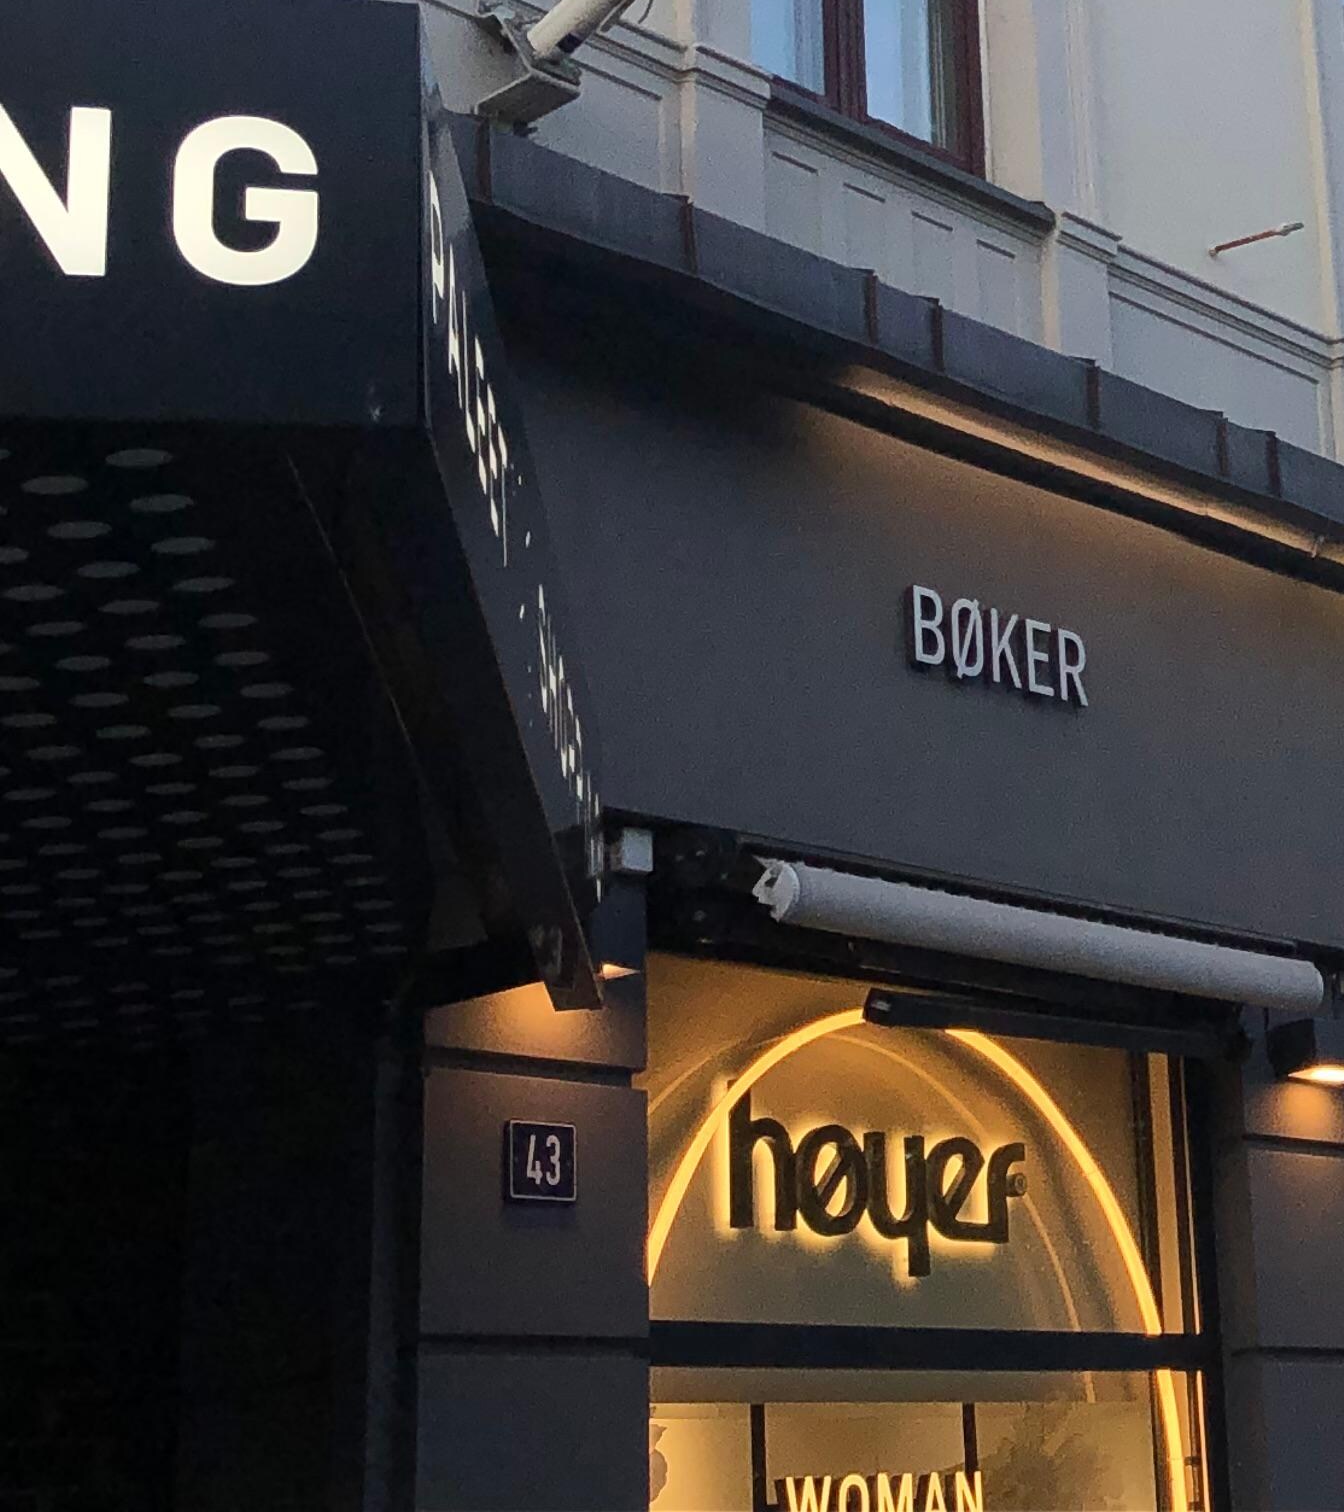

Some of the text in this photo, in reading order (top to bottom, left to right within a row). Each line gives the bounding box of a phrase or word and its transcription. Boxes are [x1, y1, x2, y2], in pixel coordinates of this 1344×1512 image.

[0, 103, 319, 286] NG
[430, 169, 508, 568] PALEET
[912, 584, 1089, 707] BØKER
[526, 1134, 561, 1186] 43
[728, 1079, 1026, 1277] høyer
[785, 1470, 984, 1512] WOMAN
